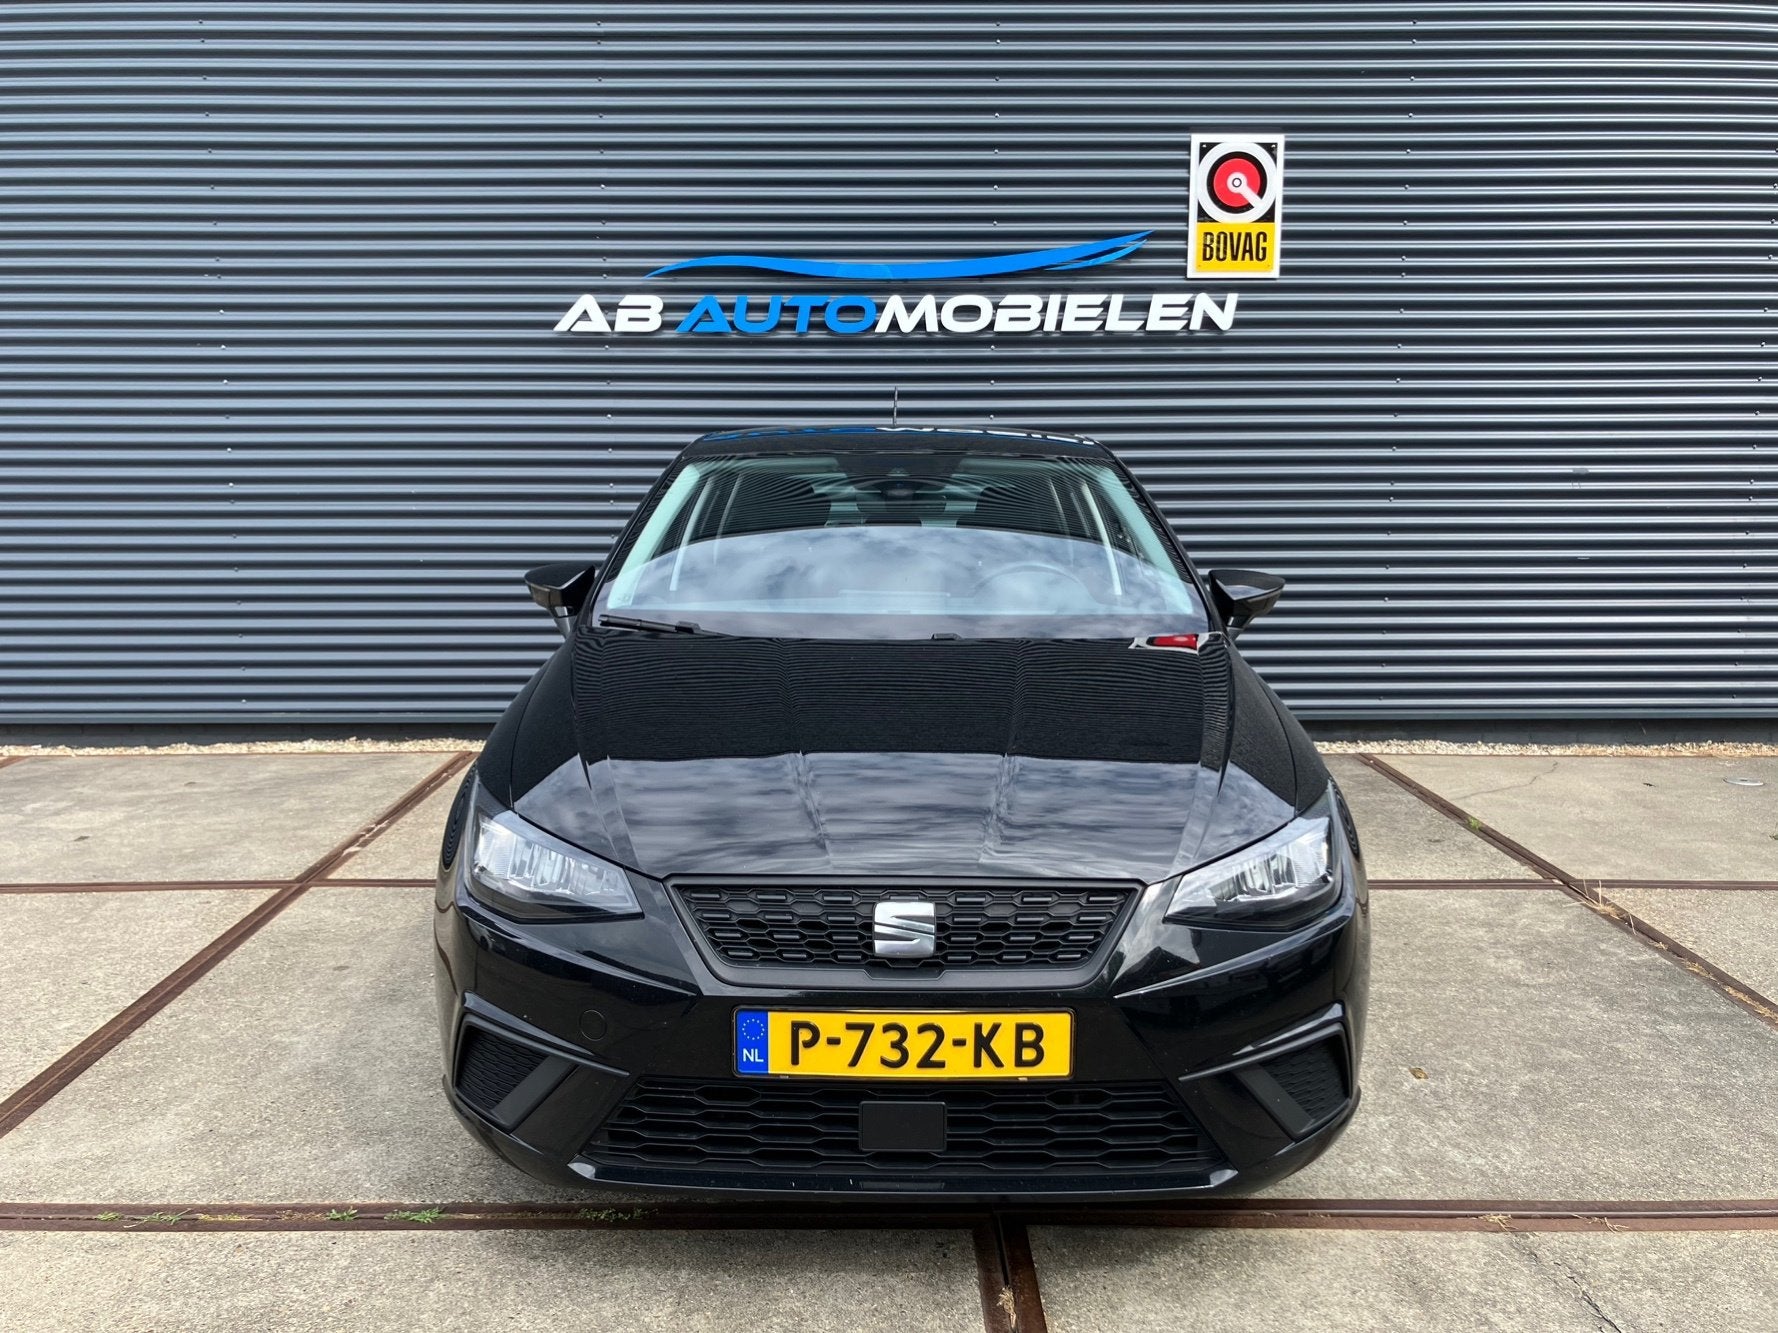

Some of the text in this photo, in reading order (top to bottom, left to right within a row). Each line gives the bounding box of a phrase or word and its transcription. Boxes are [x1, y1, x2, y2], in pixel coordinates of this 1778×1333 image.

[1202, 231, 1267, 262] BOVAG
[552, 292, 1239, 333] AB AUTOMOBIELEN
[742, 1048, 764, 1063] NL
[789, 1020, 1046, 1069] P-732-KB
